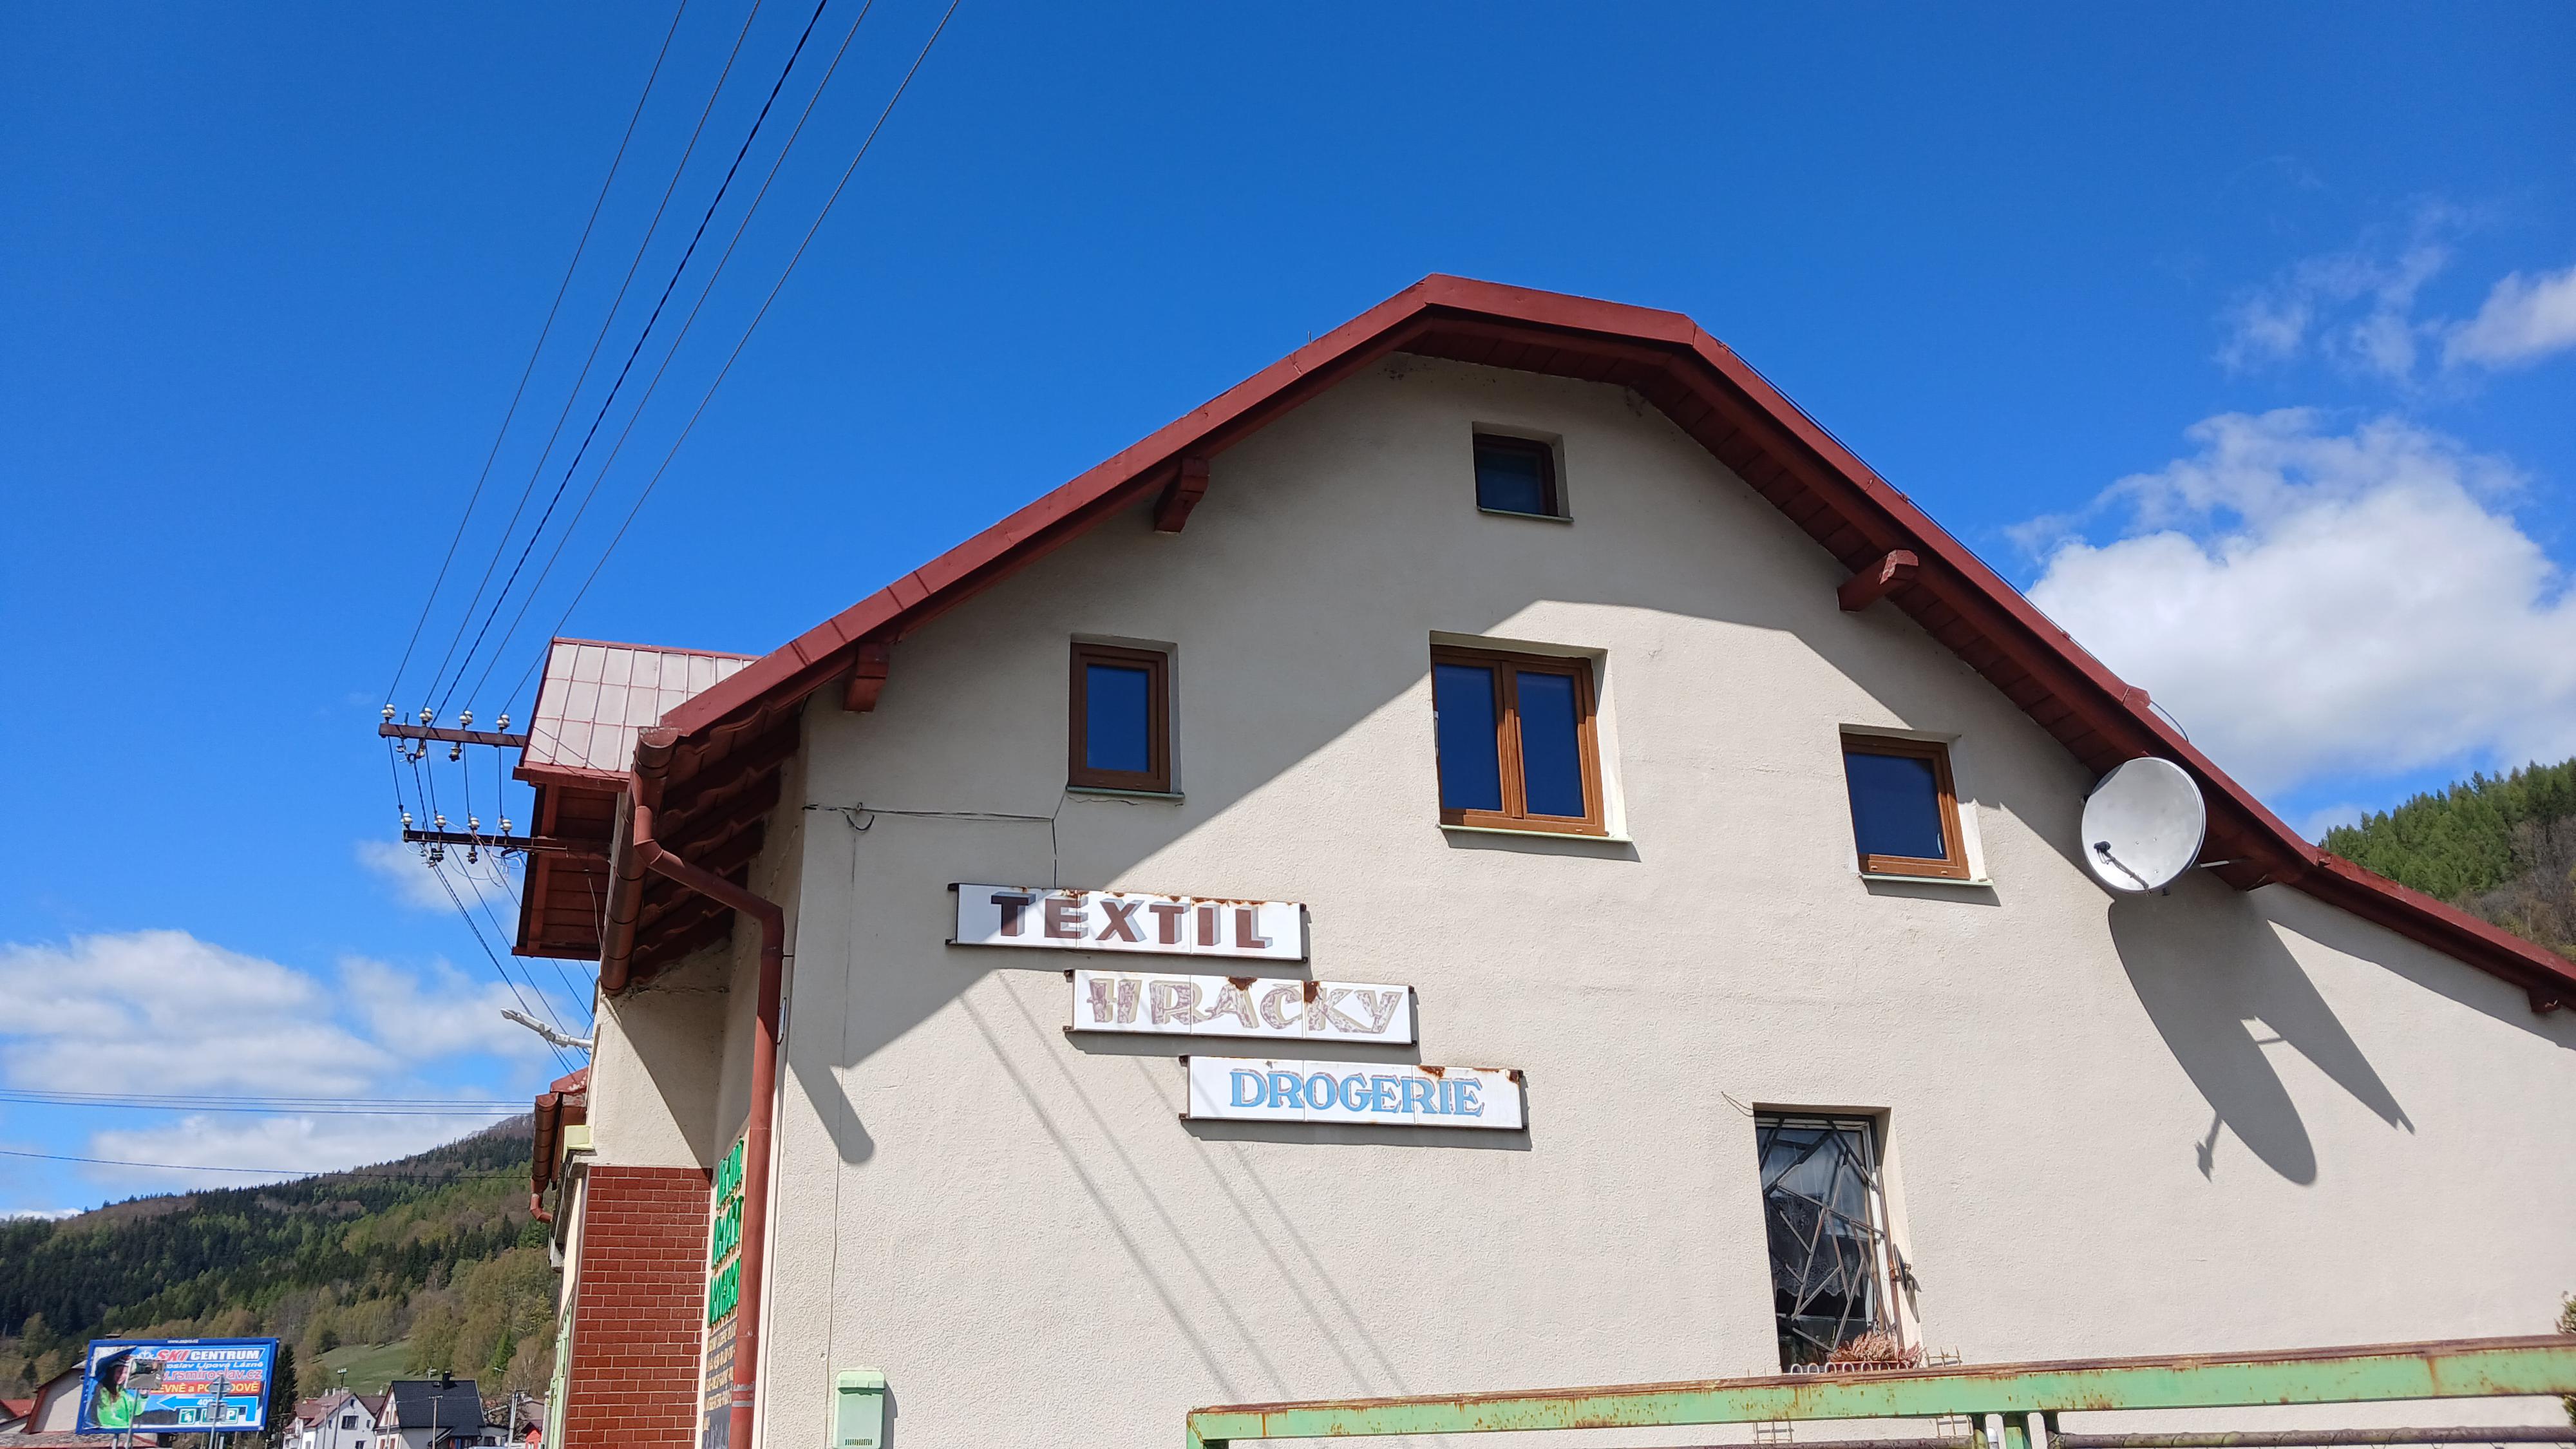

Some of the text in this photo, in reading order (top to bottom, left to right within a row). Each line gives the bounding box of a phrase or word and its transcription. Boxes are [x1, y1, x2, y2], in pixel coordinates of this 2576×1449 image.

[990, 891, 1273, 949] TEXTIL
[1086, 978, 1403, 1034] HRAČKY
[1229, 1068, 1484, 1117] DROGERIE
[156, 1349, 260, 1361] SKI CENTRUM
